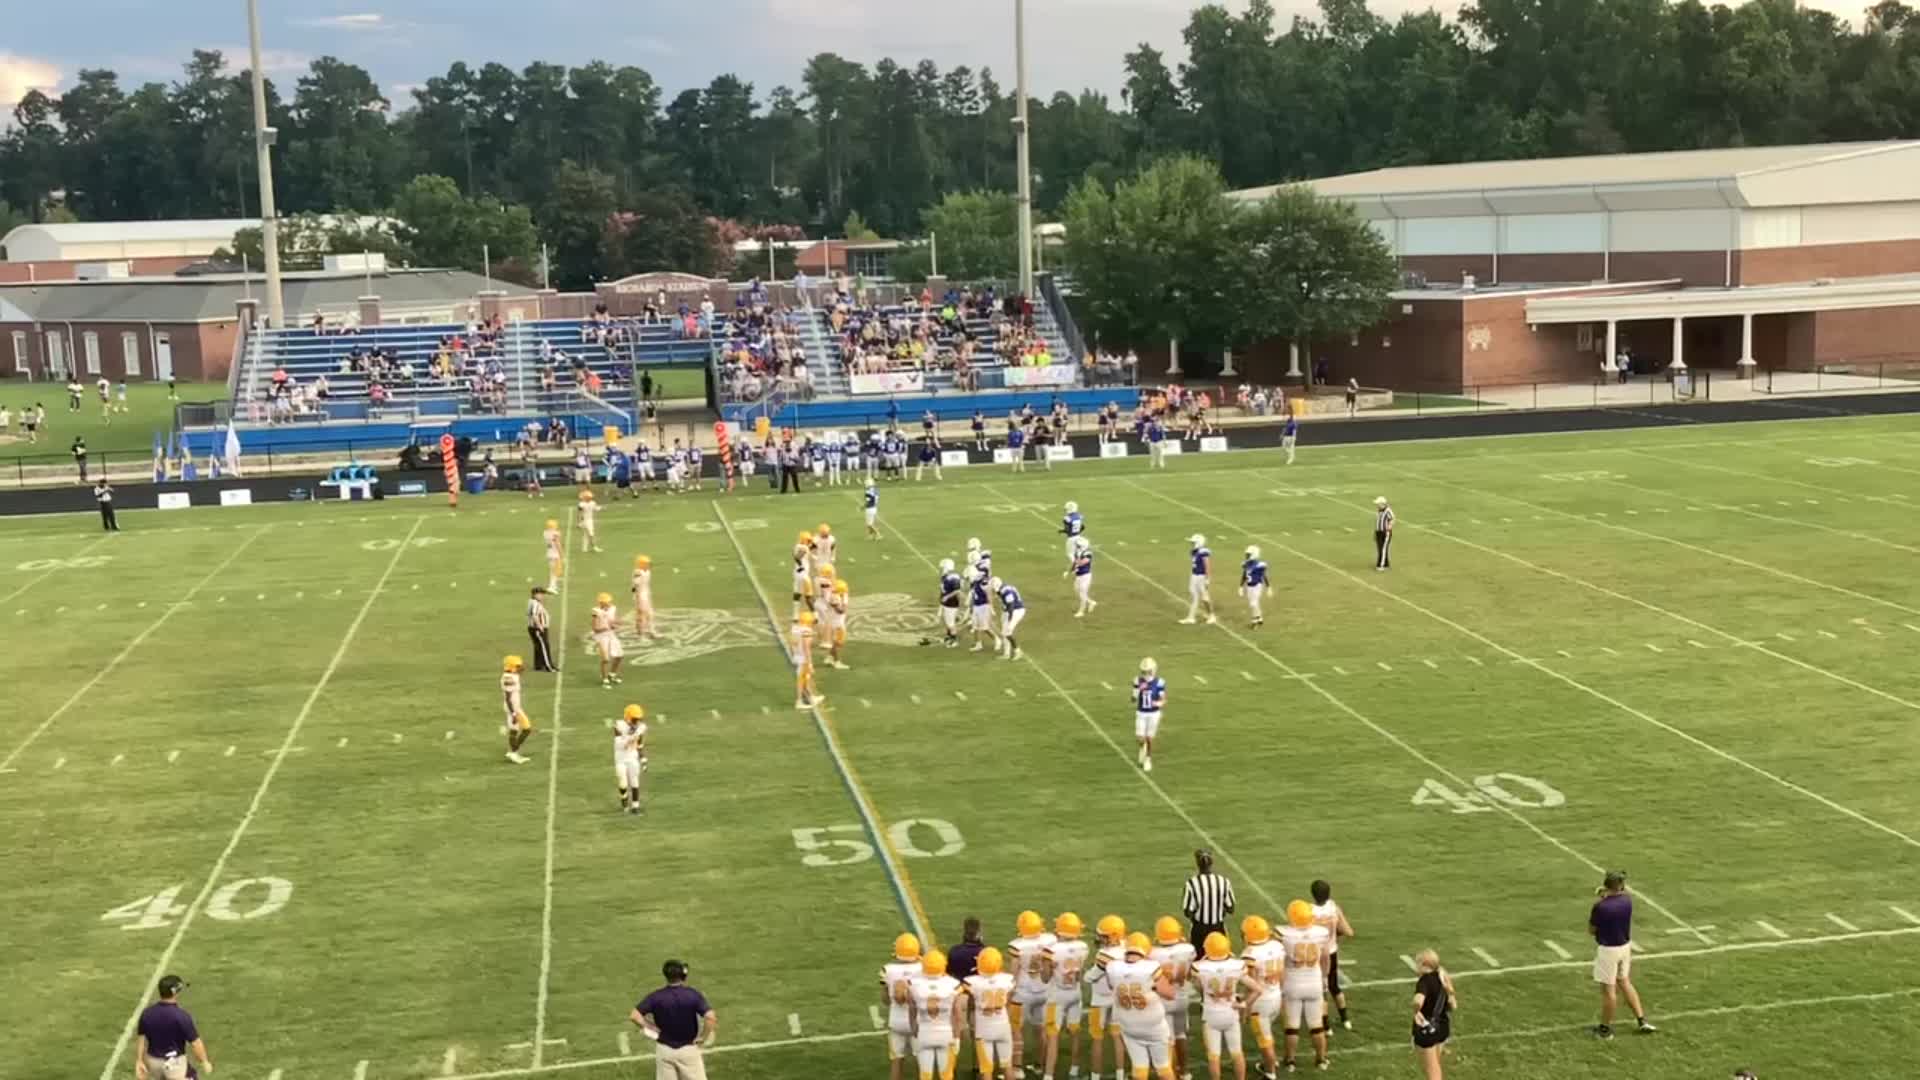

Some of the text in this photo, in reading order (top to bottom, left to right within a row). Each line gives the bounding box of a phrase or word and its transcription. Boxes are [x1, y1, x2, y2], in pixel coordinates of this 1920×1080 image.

[1411, 773, 1565, 813] 40
[792, 818, 966, 866] 50
[101, 877, 293, 930] 40
[1117, 982, 1148, 1009] 65
